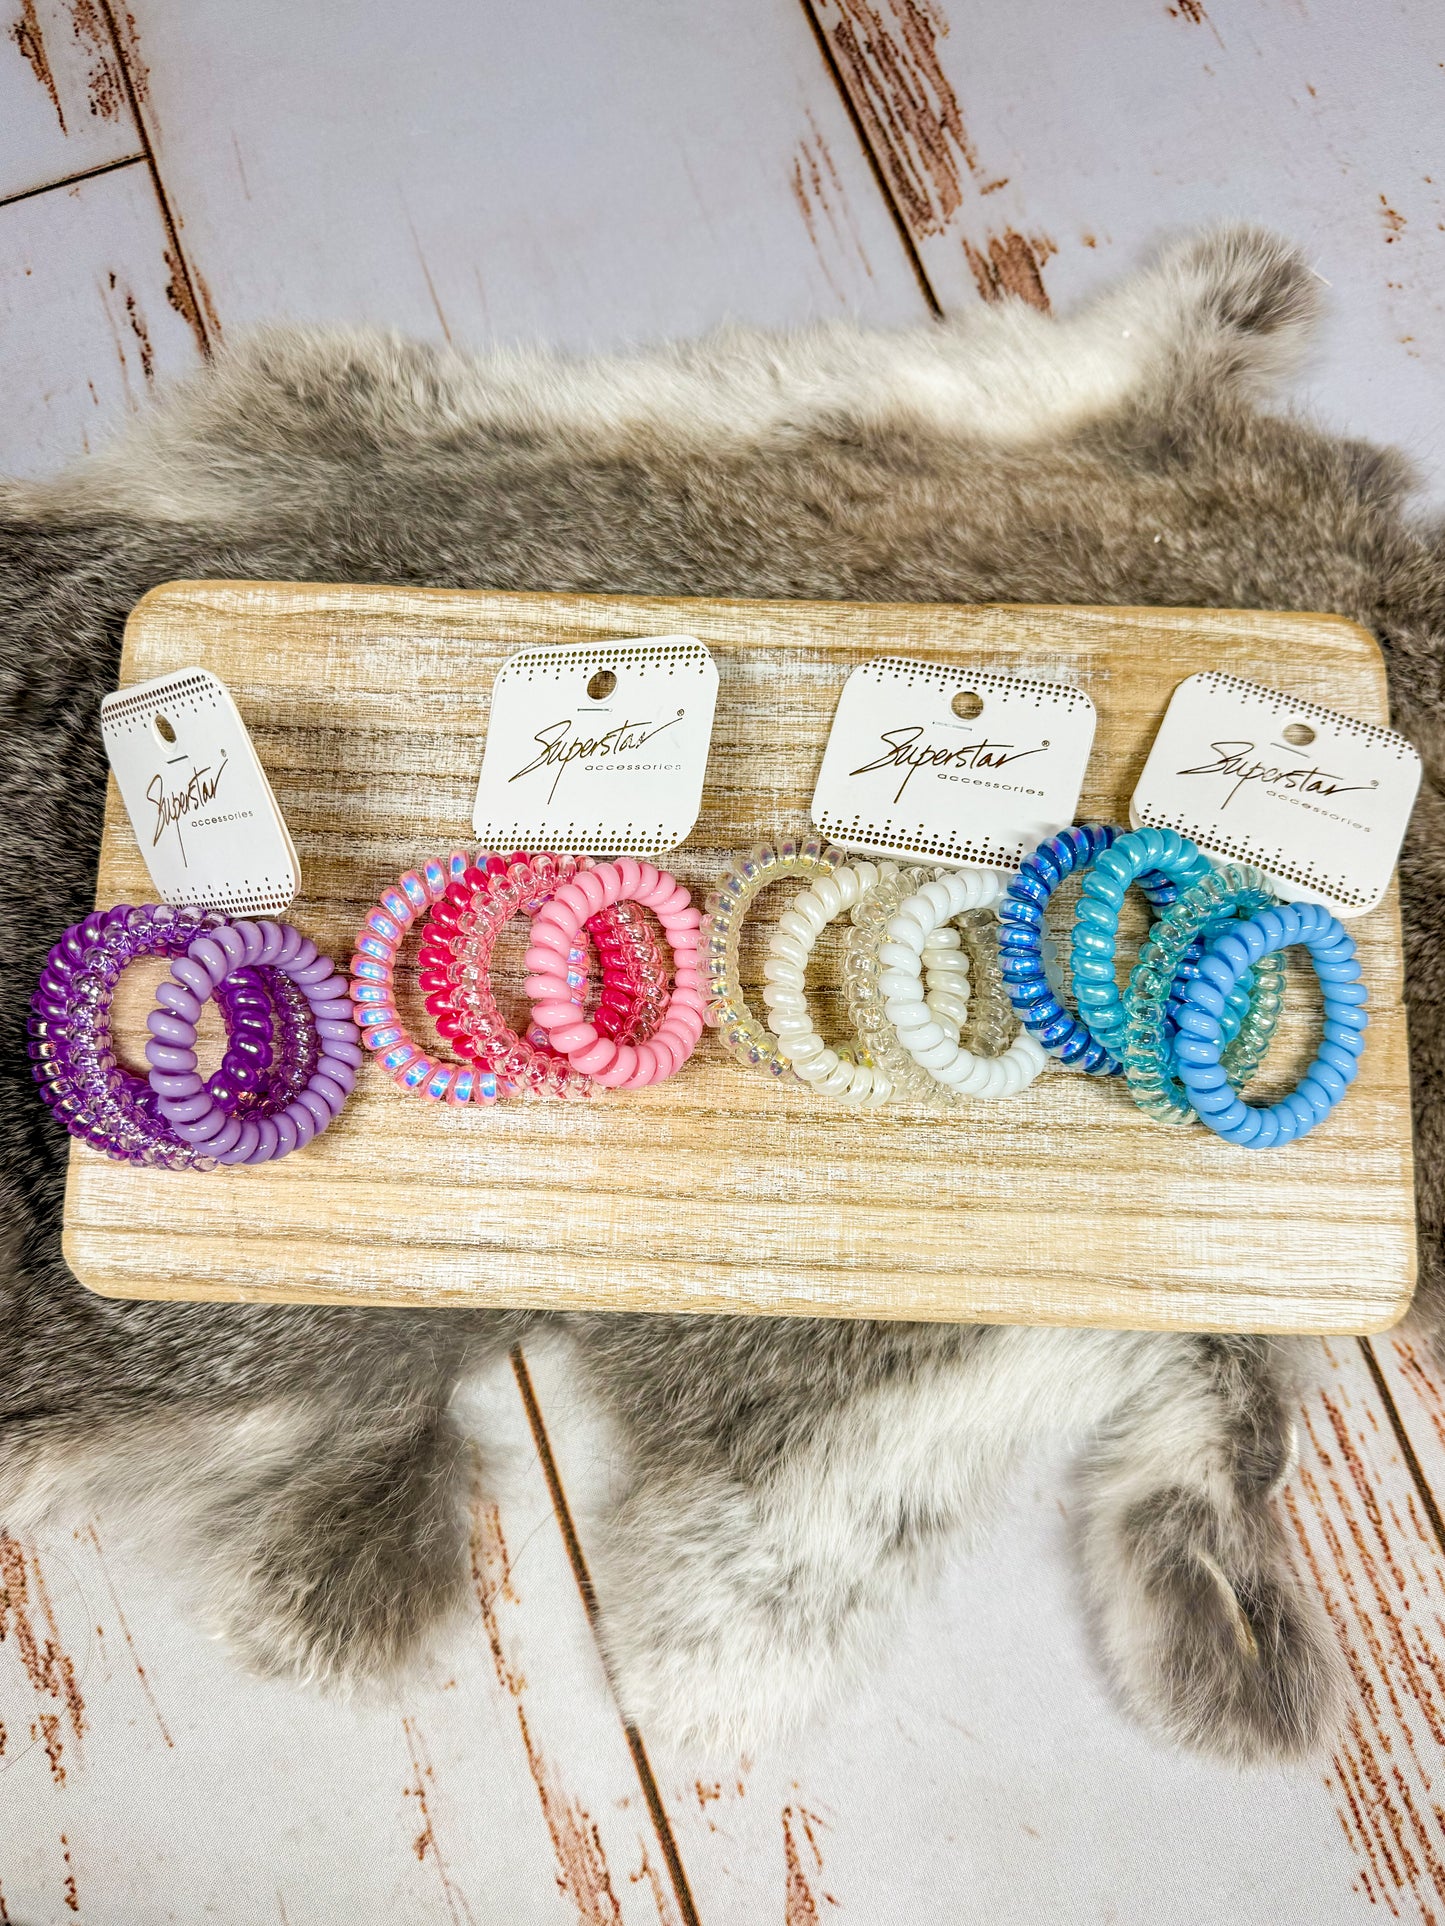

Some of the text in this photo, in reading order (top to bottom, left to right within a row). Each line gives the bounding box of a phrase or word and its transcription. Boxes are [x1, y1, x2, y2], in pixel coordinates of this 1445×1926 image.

[508, 717, 683, 805] Superstar
[849, 726, 1048, 804] Superstar
[937, 773, 1045, 796] accessories
[1176, 741, 1377, 810] Superstar
[146, 758, 229, 868] Superstar
[191, 809, 254, 828] accessories
[1266, 789, 1371, 833] accessories
